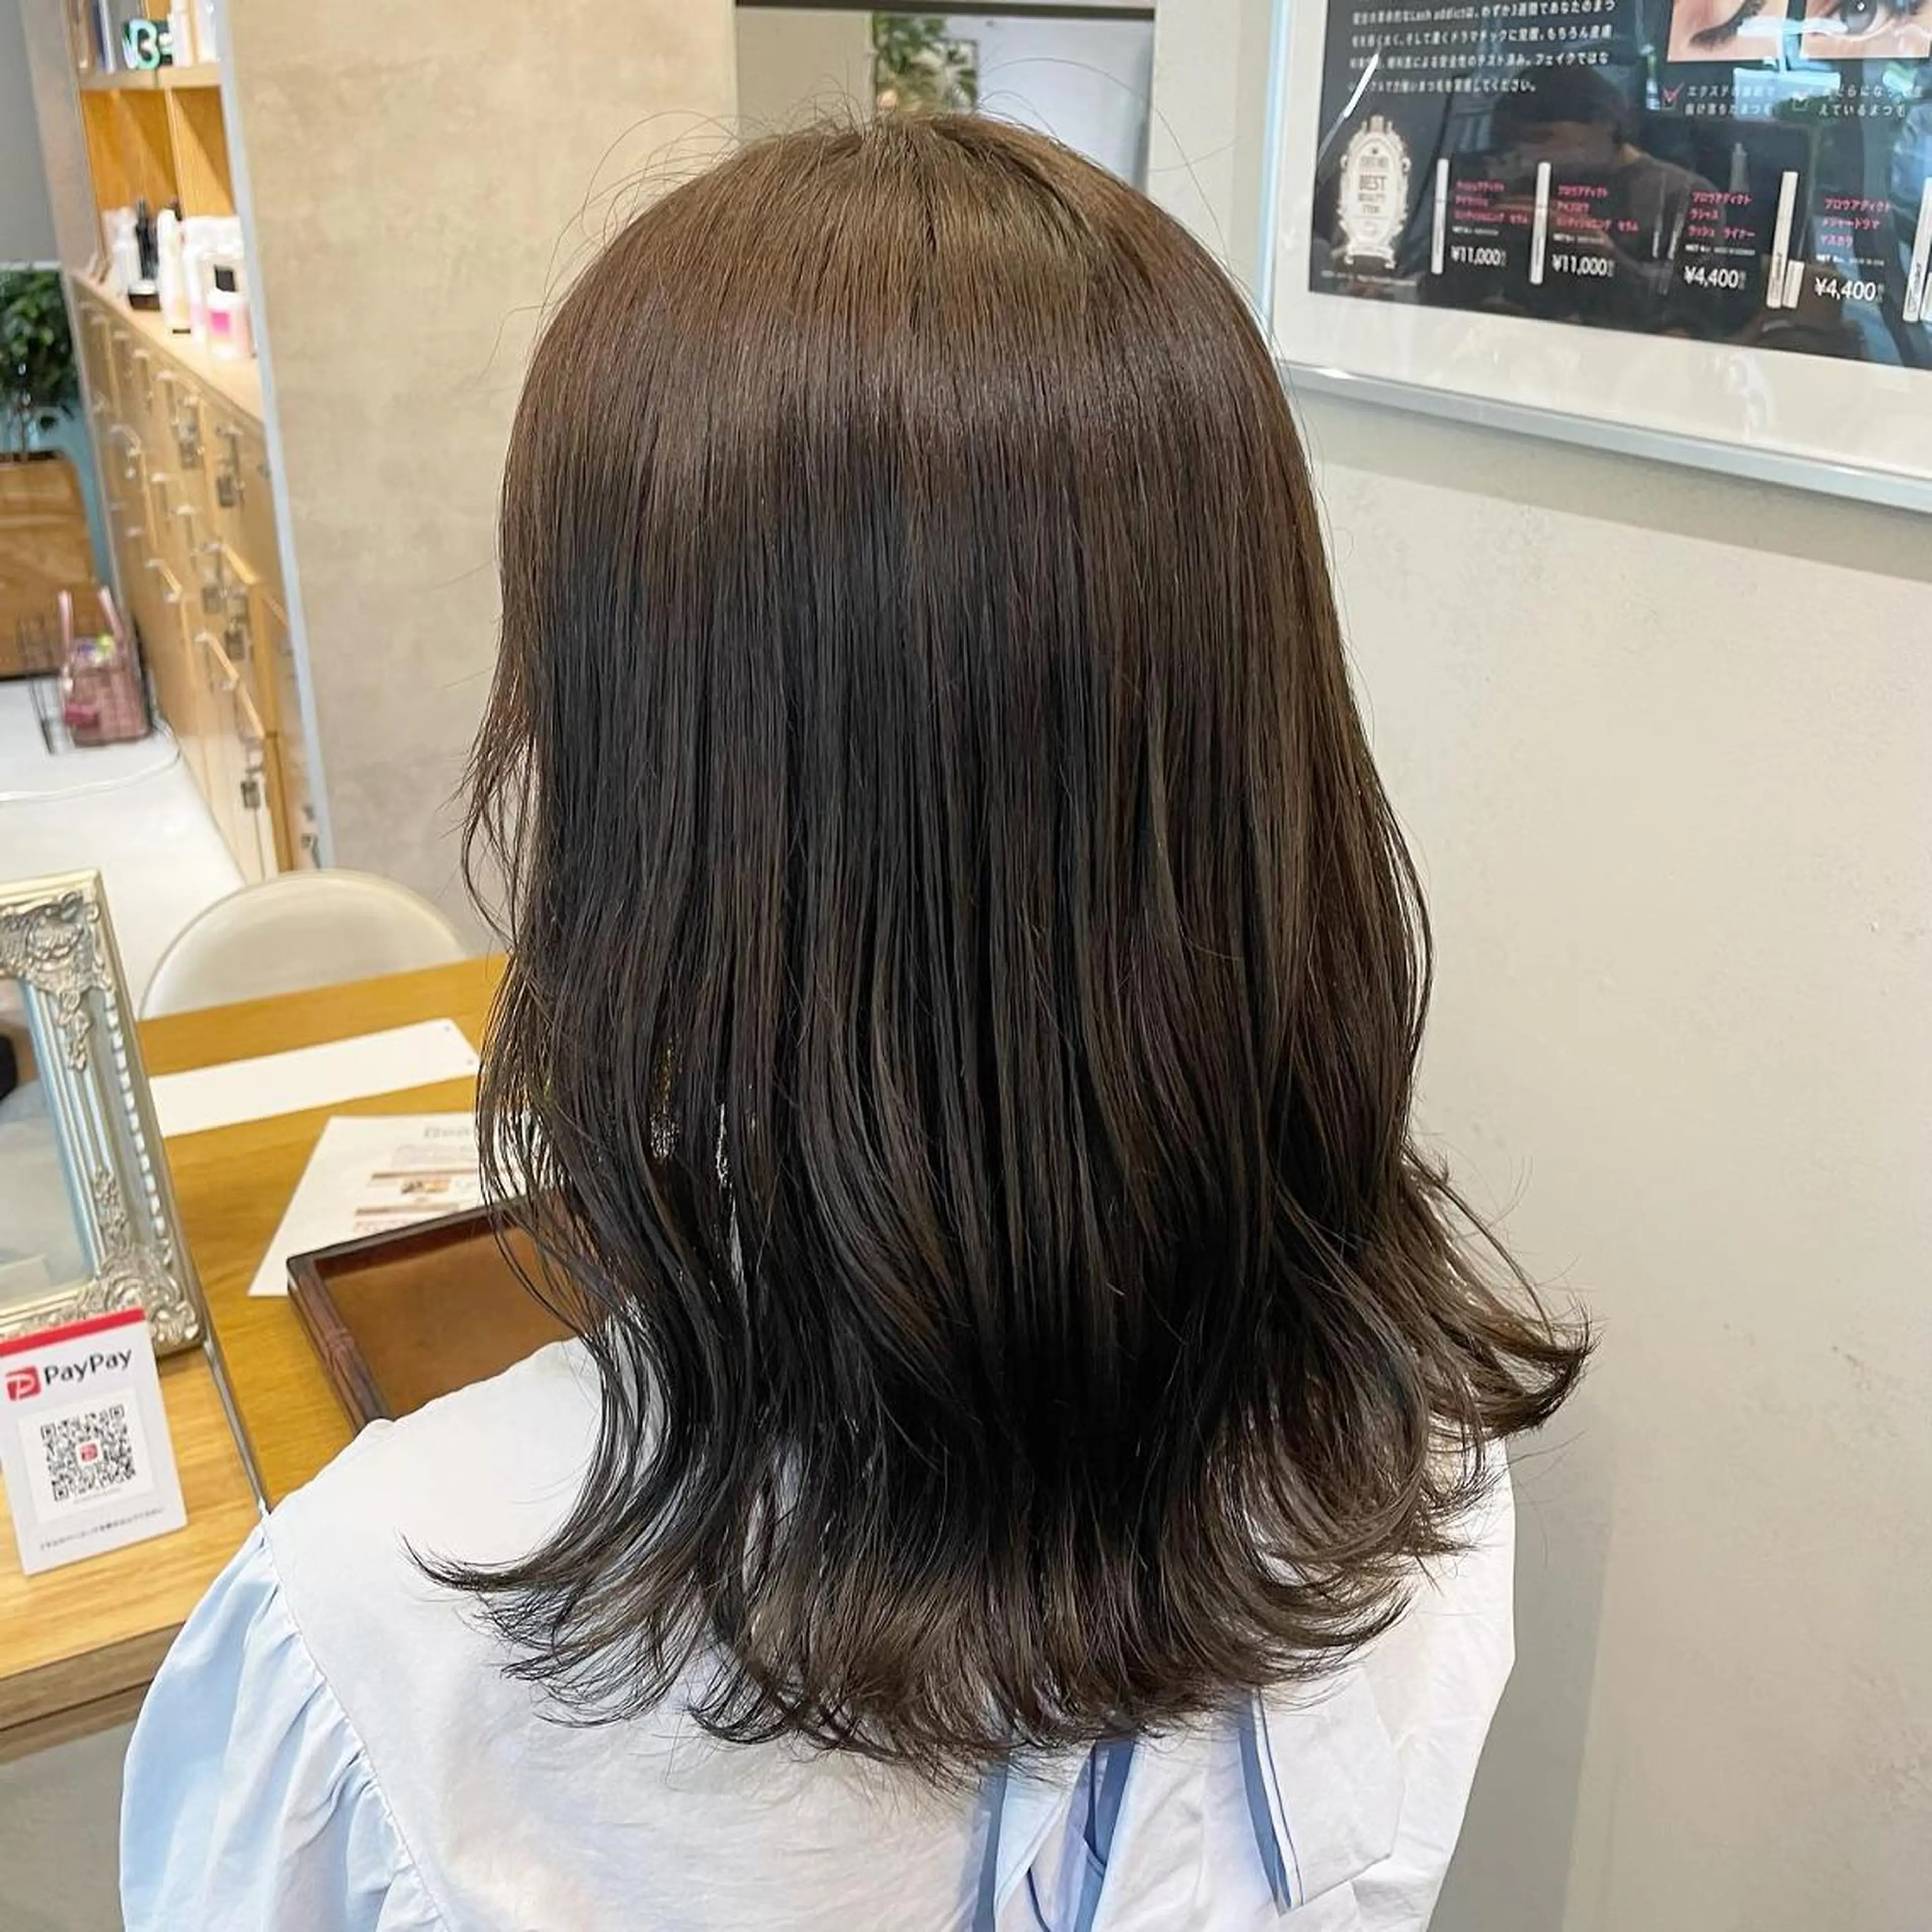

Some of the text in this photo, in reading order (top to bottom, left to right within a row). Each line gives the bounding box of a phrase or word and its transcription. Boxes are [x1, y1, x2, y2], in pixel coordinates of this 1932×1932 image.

[1551, 254, 1608, 276] ¥11,000
[1684, 265, 1739, 288] ¥4,400
[1814, 276, 1877, 302] ¥4,400
[44, 1349, 132, 1386] PayPay
